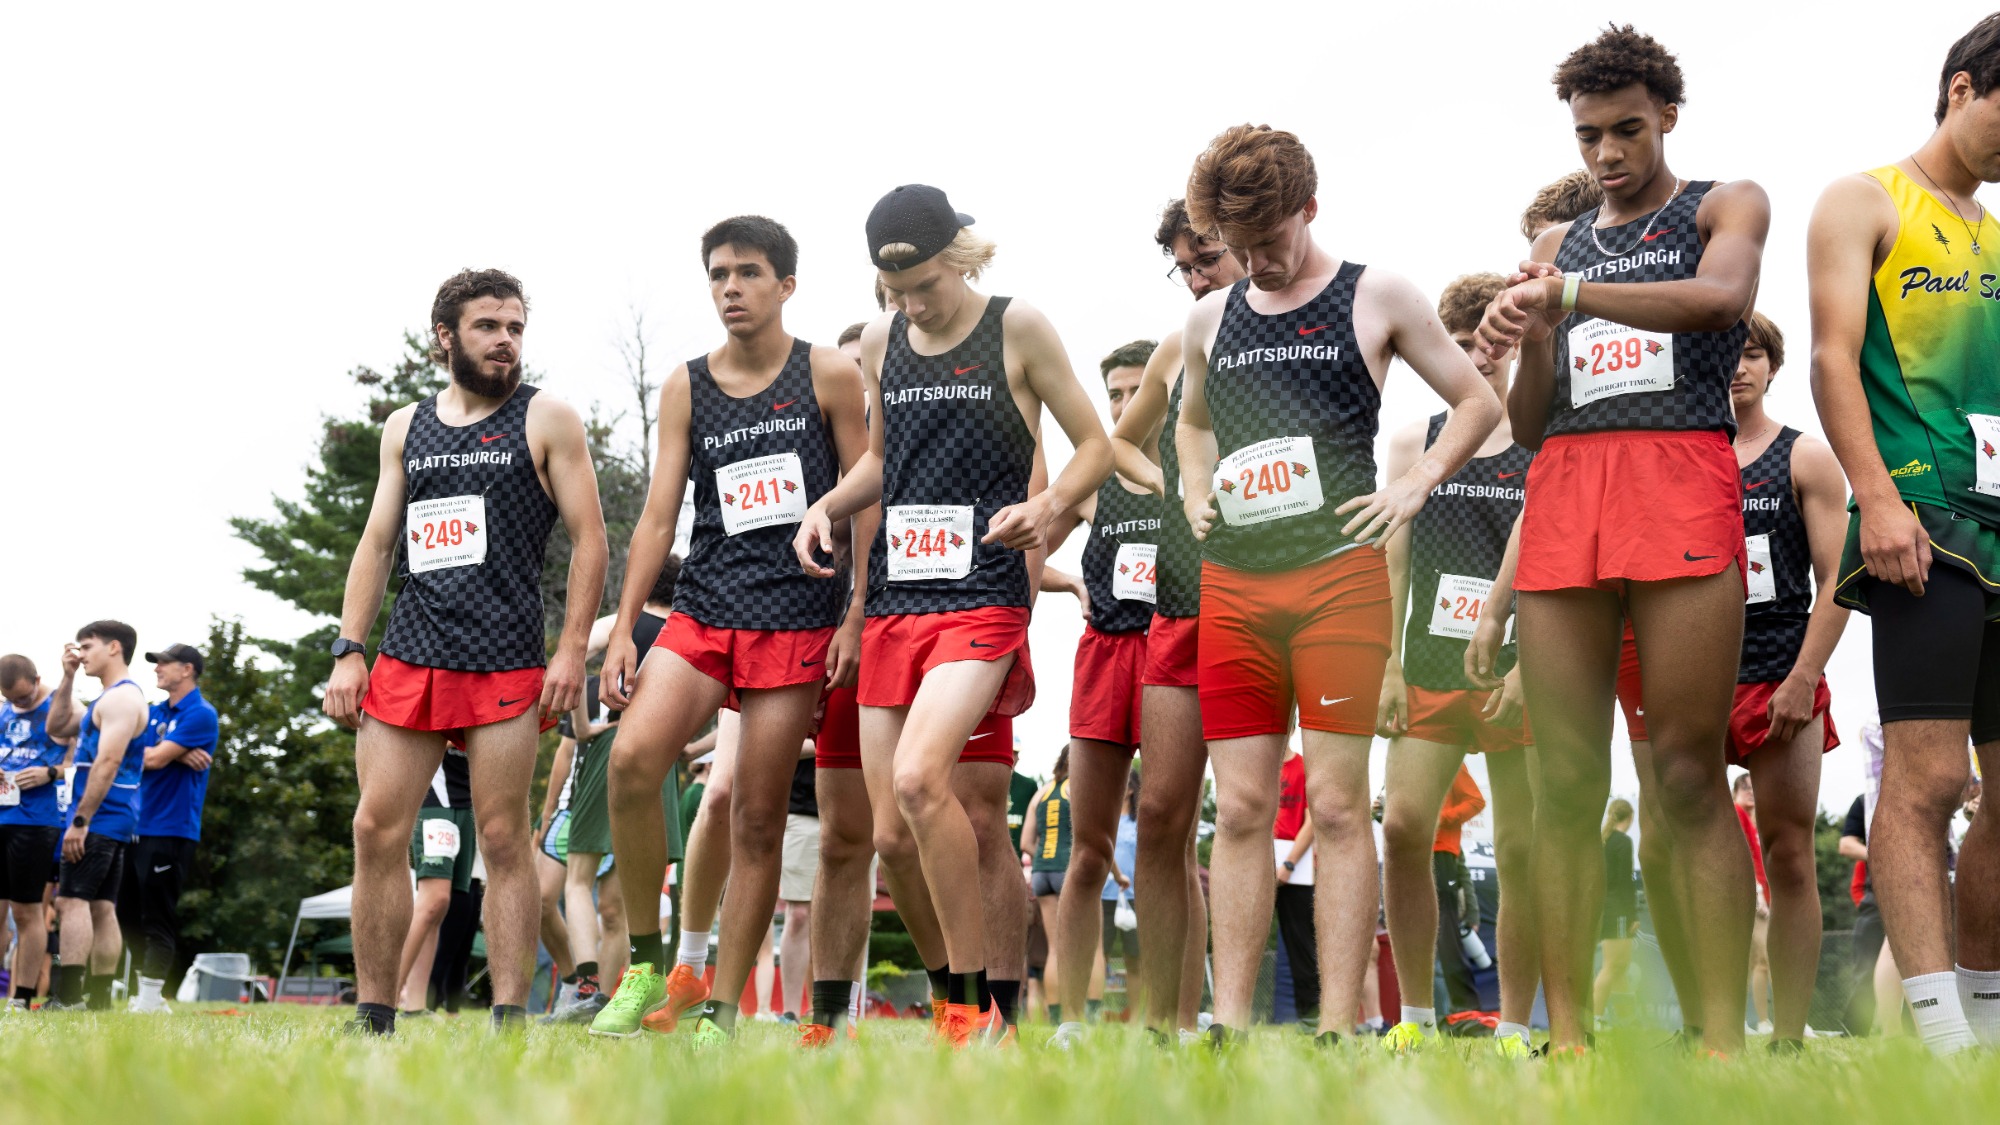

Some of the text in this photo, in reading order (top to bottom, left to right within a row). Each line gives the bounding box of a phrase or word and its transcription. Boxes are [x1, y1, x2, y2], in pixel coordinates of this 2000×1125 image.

[1899, 266, 1970, 299] Paul
[1217, 345, 1339, 372] PLATTSBURGH
[1591, 337, 1642, 376] 239
[884, 385, 992, 406] PLATTSBURGH
[1629, 378, 1657, 388] TIMING
[704, 417, 806, 450] PLATTSBURGH
[408, 451, 512, 473] PLATTSBURGH
[1264, 445, 1294, 458] CLASSIC
[1239, 460, 1291, 500] 240
[1430, 483, 1525, 501] PLATTSBURGH
[739, 478, 781, 511] 241
[1283, 500, 1309, 511] TIMING
[774, 512, 796, 521] TIMING
[423, 518, 463, 550] 249
[904, 528, 947, 558] 244
[1453, 596, 1486, 621] 24
[1912, 998, 1938, 1009] PUMA
